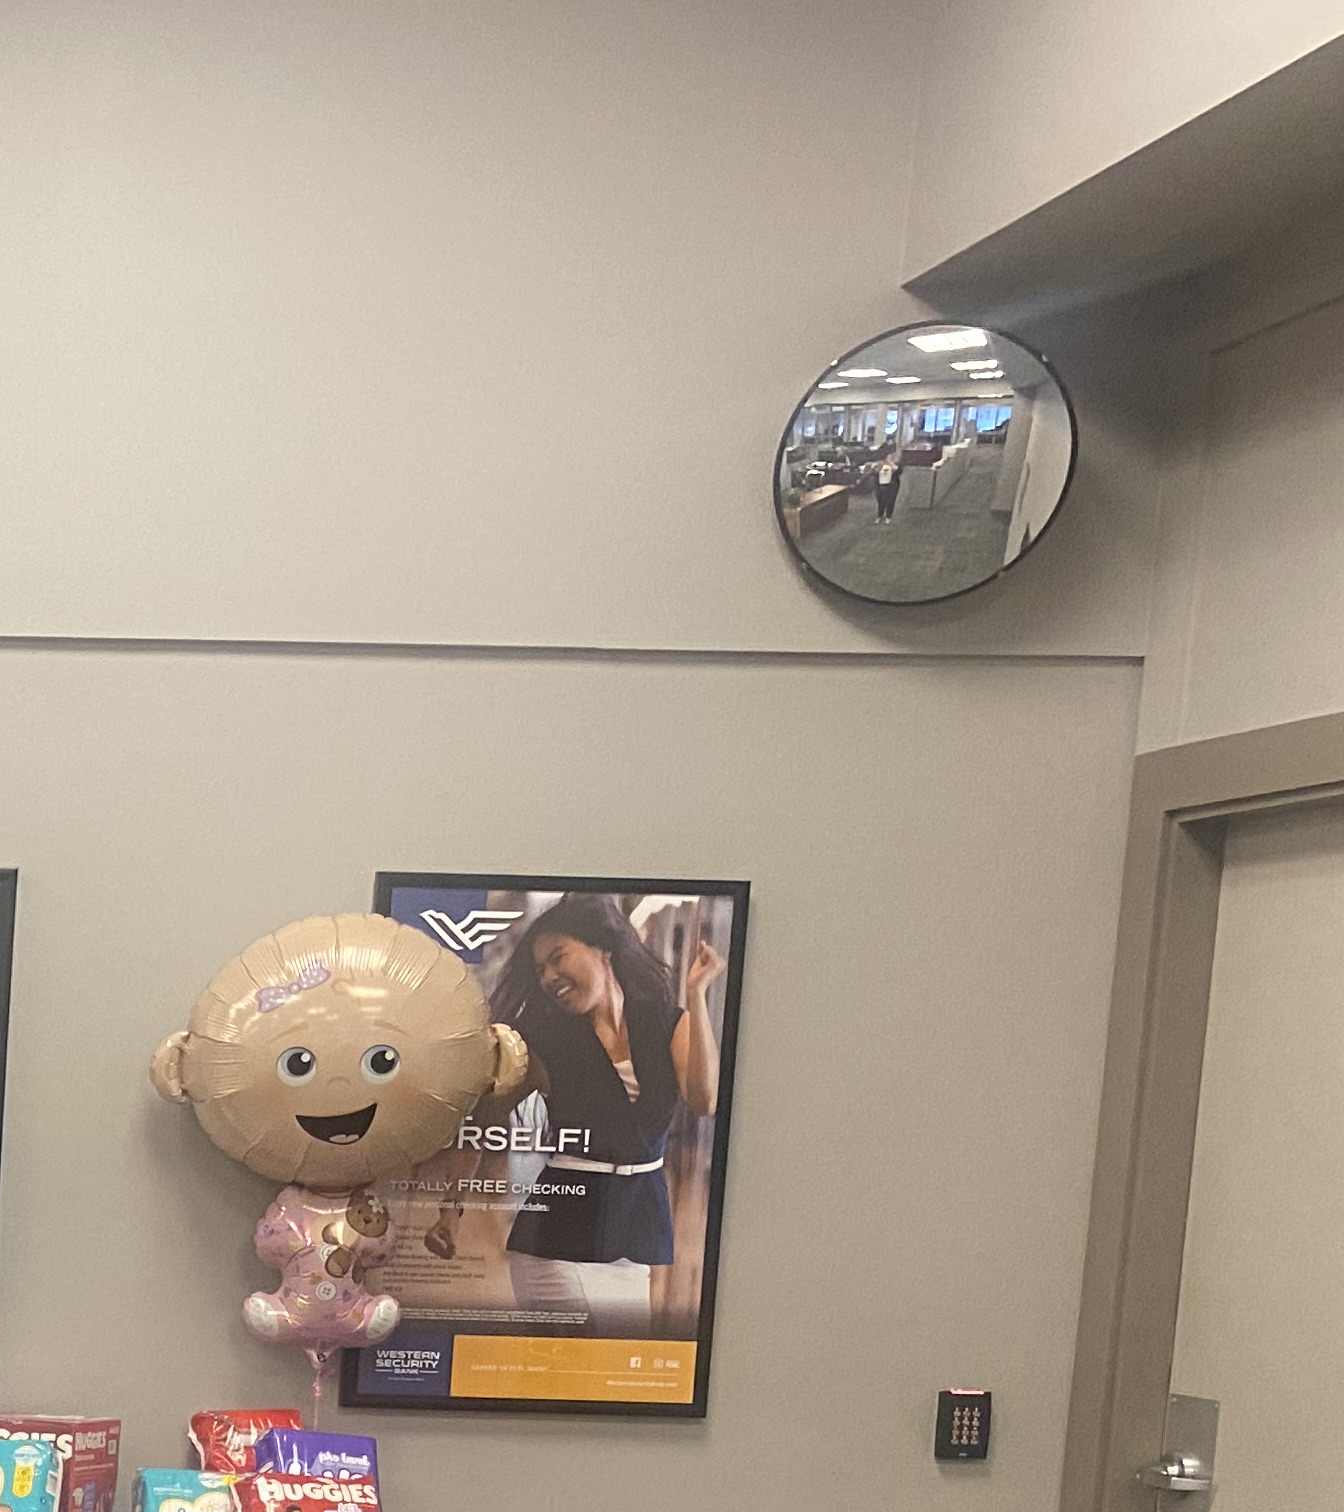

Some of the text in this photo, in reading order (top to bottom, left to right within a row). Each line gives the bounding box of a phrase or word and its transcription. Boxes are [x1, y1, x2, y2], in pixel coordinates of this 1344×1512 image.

[457, 1125, 591, 1152] RSELF!
[391, 1179, 586, 1195] TOTALLY FREE CHECKING
[377, 1350, 440, 1360] WESTERN
[375, 1359, 438, 1369] SECURITY
[256, 1476, 378, 1505] HUGGIES
